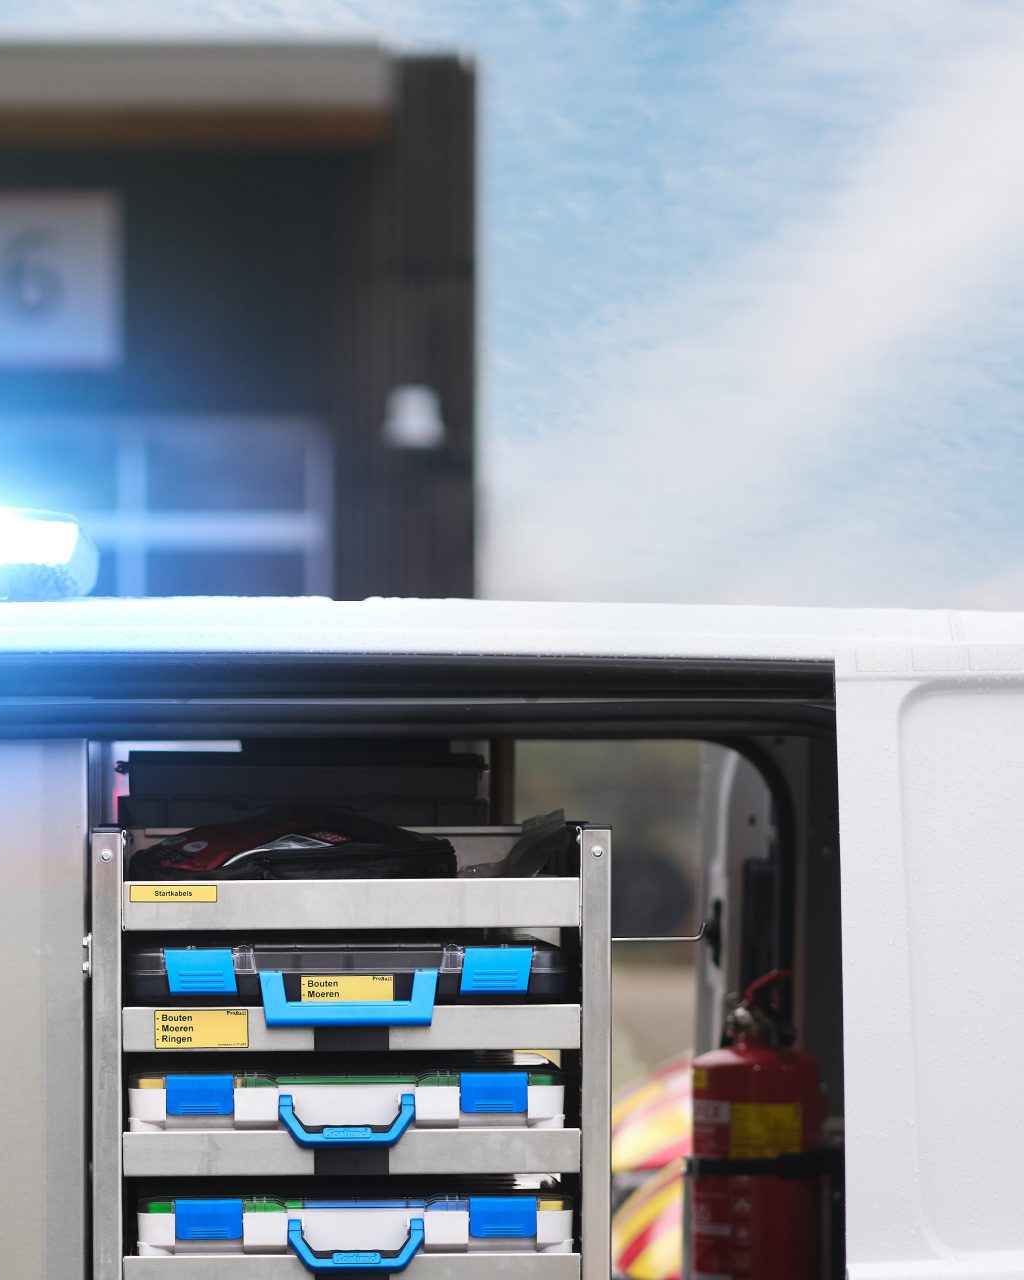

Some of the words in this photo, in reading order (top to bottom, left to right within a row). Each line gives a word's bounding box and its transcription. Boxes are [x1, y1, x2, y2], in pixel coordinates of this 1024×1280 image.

[307, 980, 339, 988] Bouten
[161, 1014, 193, 1022] Bouten
[161, 1035, 192, 1044] Ringen
